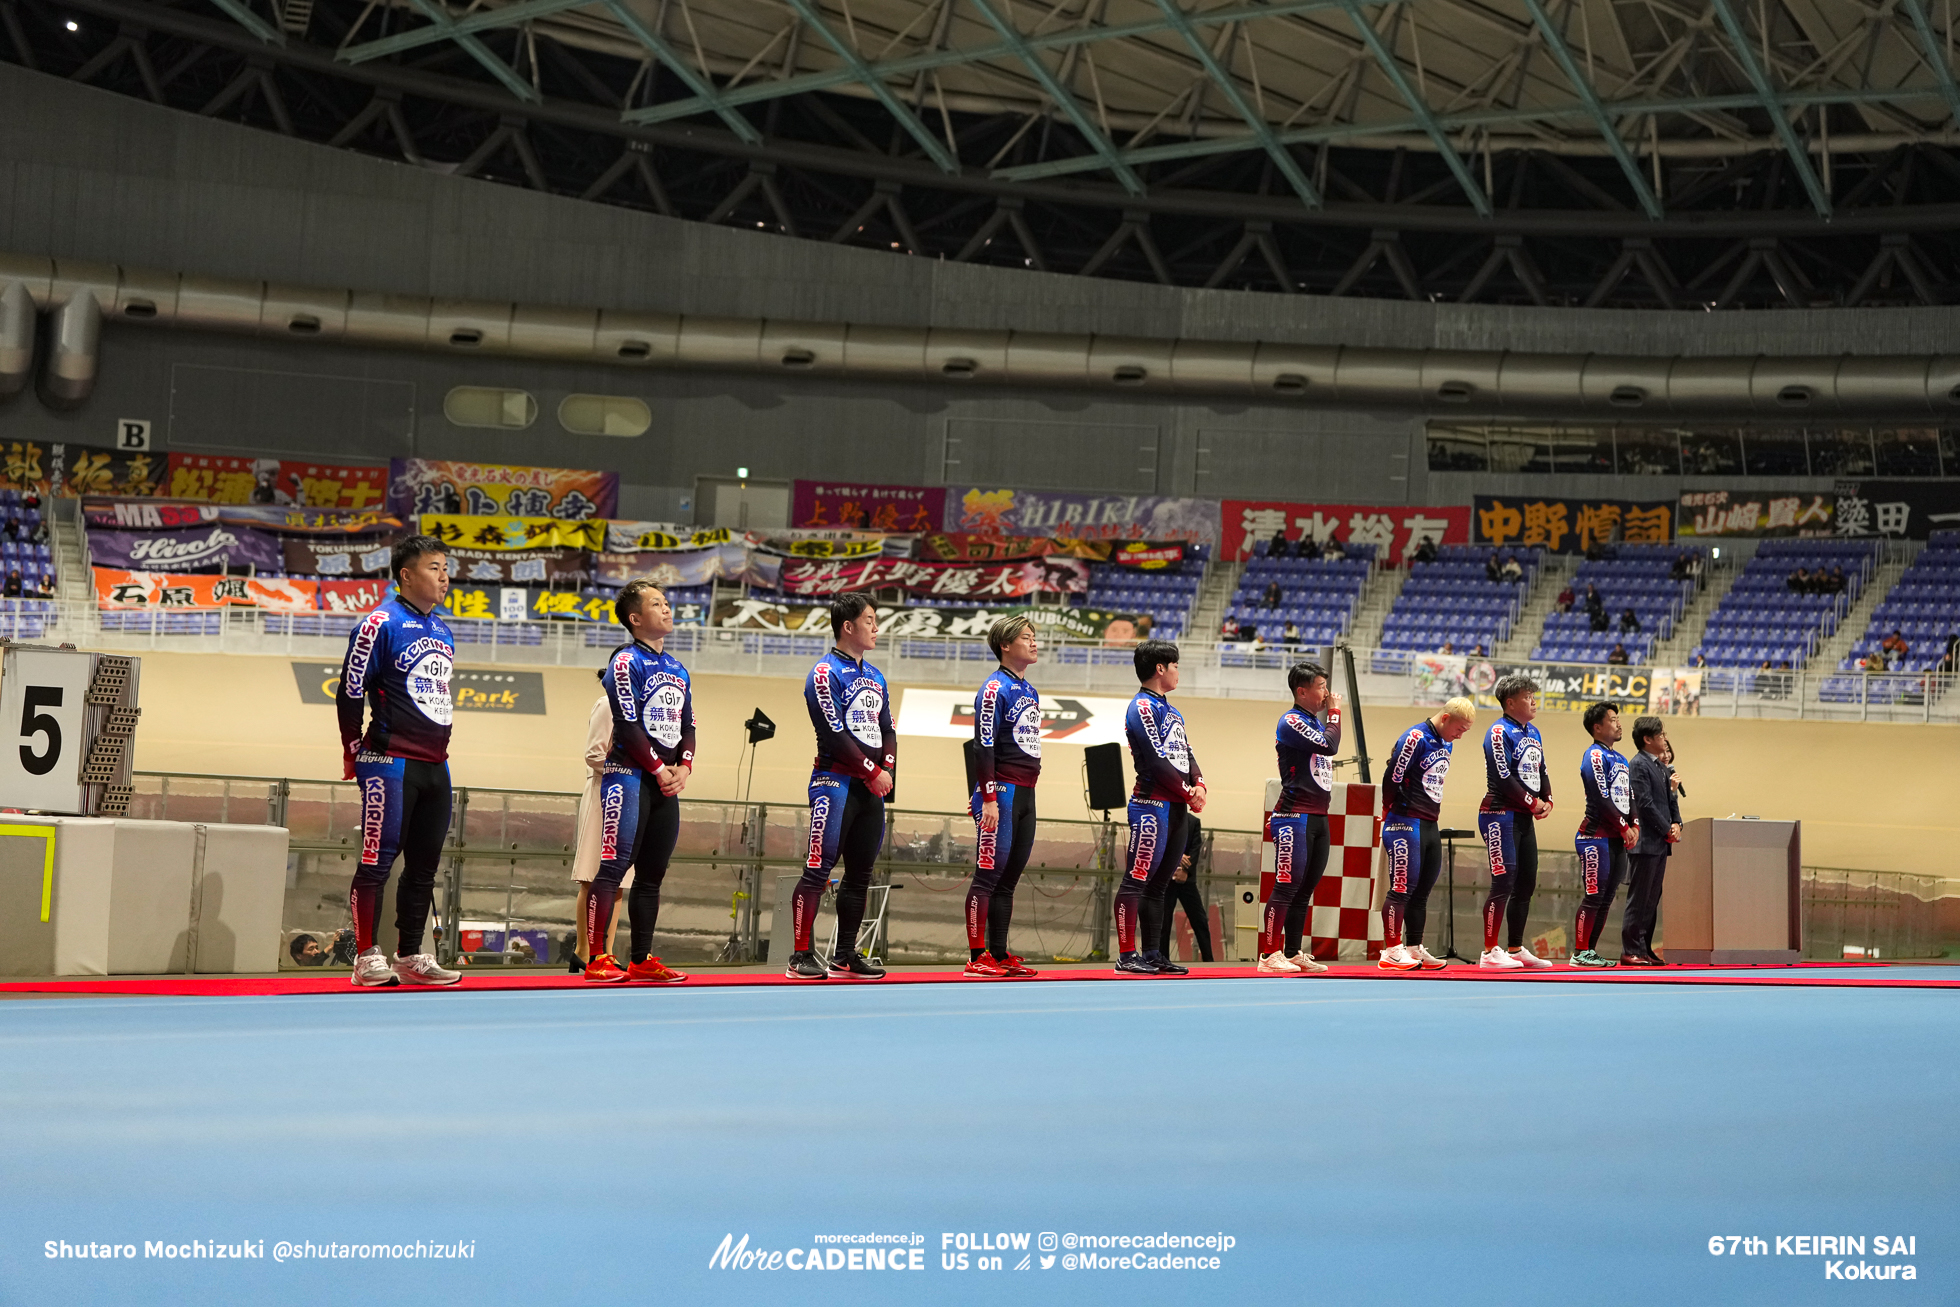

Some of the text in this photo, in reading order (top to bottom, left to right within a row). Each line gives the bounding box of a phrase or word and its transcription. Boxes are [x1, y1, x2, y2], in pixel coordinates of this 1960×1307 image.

[122, 423, 145, 448] B
[307, 543, 381, 554] TOKUSHIMA
[1241, 508, 1448, 559] 清水裕友
[345, 610, 390, 699] KEIRINSAI
[457, 687, 519, 704] Park
[613, 652, 638, 722] KEIRINSAI
[19, 685, 63, 775] 5
[361, 776, 386, 866] KEIRINSAI
